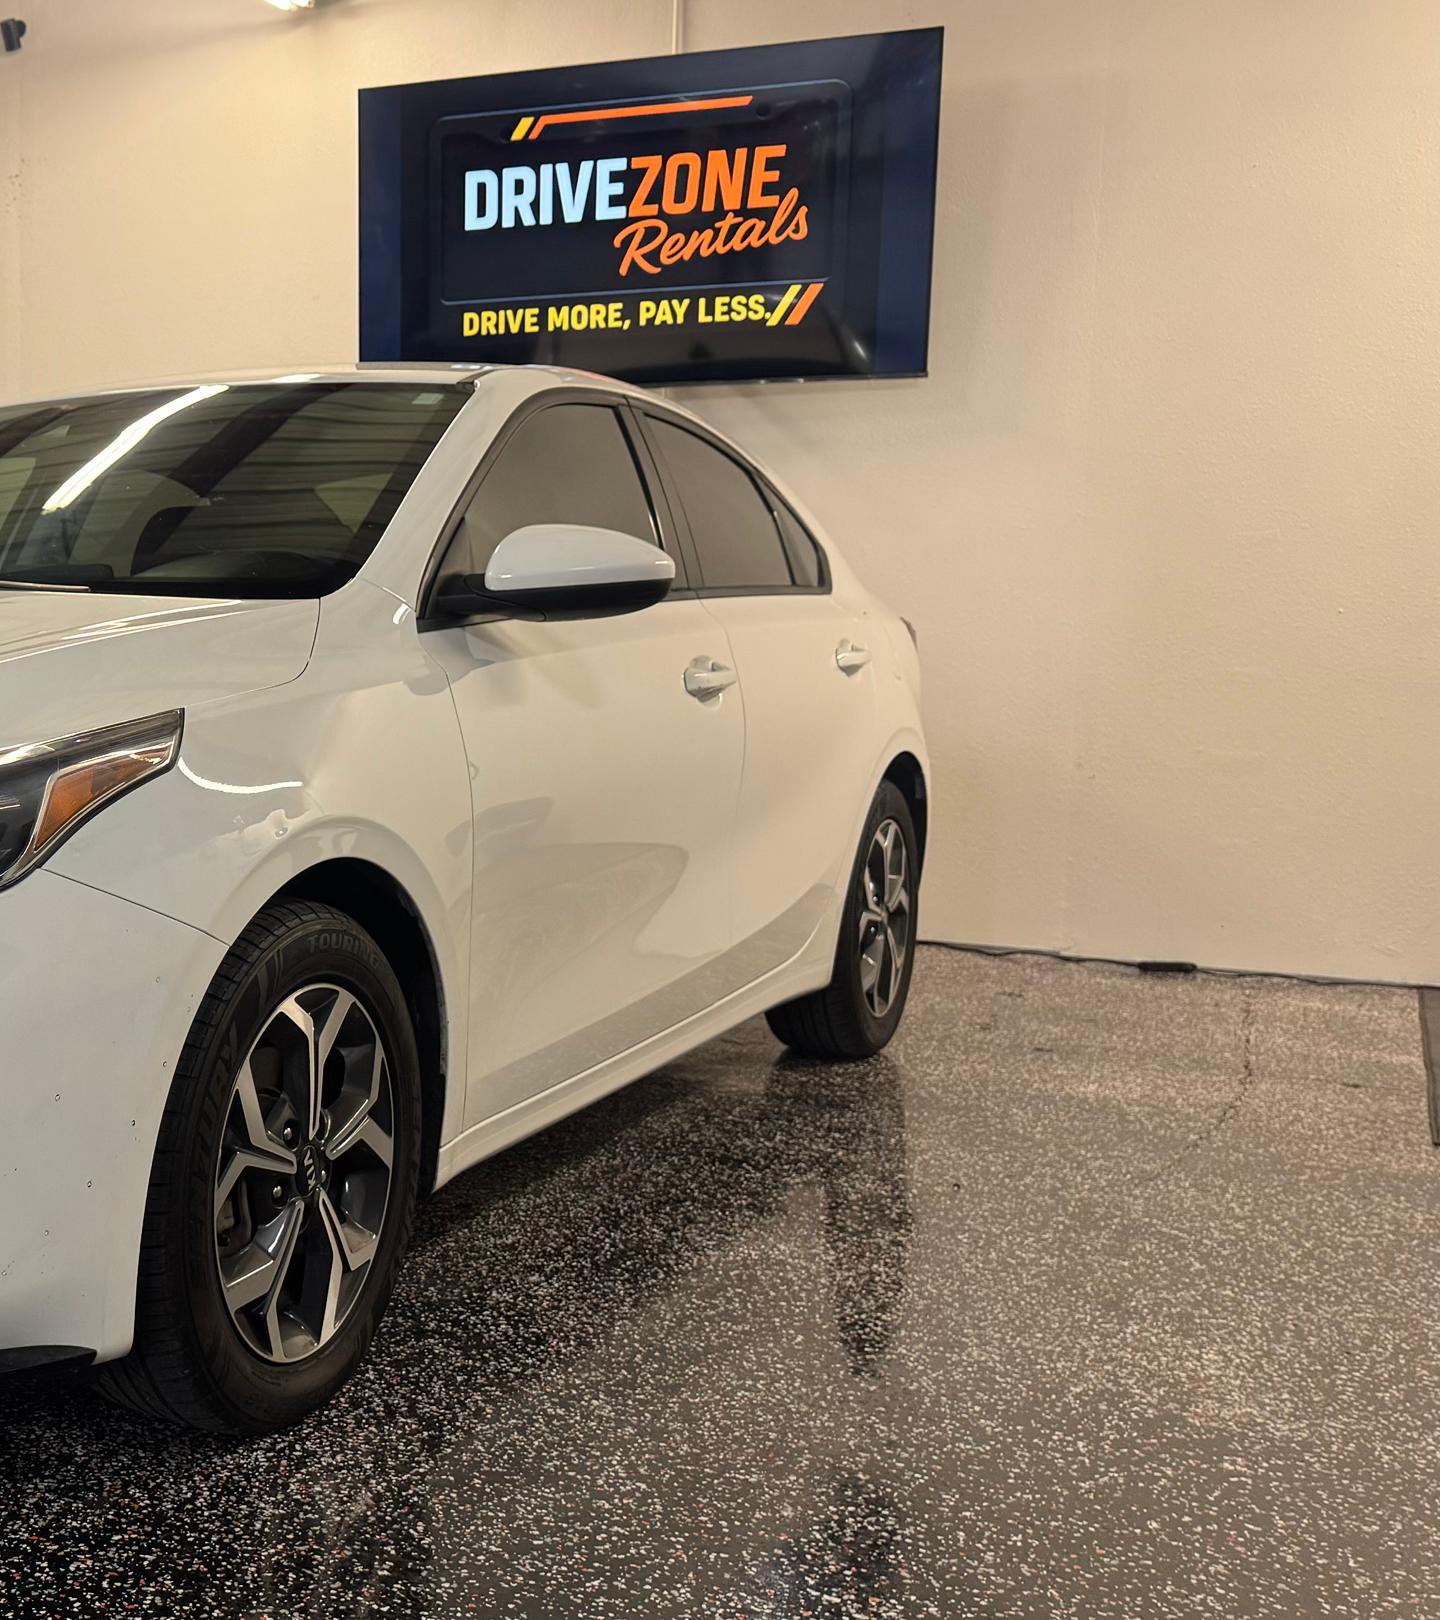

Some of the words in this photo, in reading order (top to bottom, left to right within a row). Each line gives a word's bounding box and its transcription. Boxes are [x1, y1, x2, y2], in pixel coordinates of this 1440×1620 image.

[464, 144, 787, 231] DRIVEZONE
[613, 187, 809, 277] Rentals
[462, 308, 540, 337] DRIVE
[547, 302, 631, 332] MORE,
[638, 297, 691, 327] PAY
[697, 294, 772, 325] LESS.
[306, 932, 381, 968] TOURING
